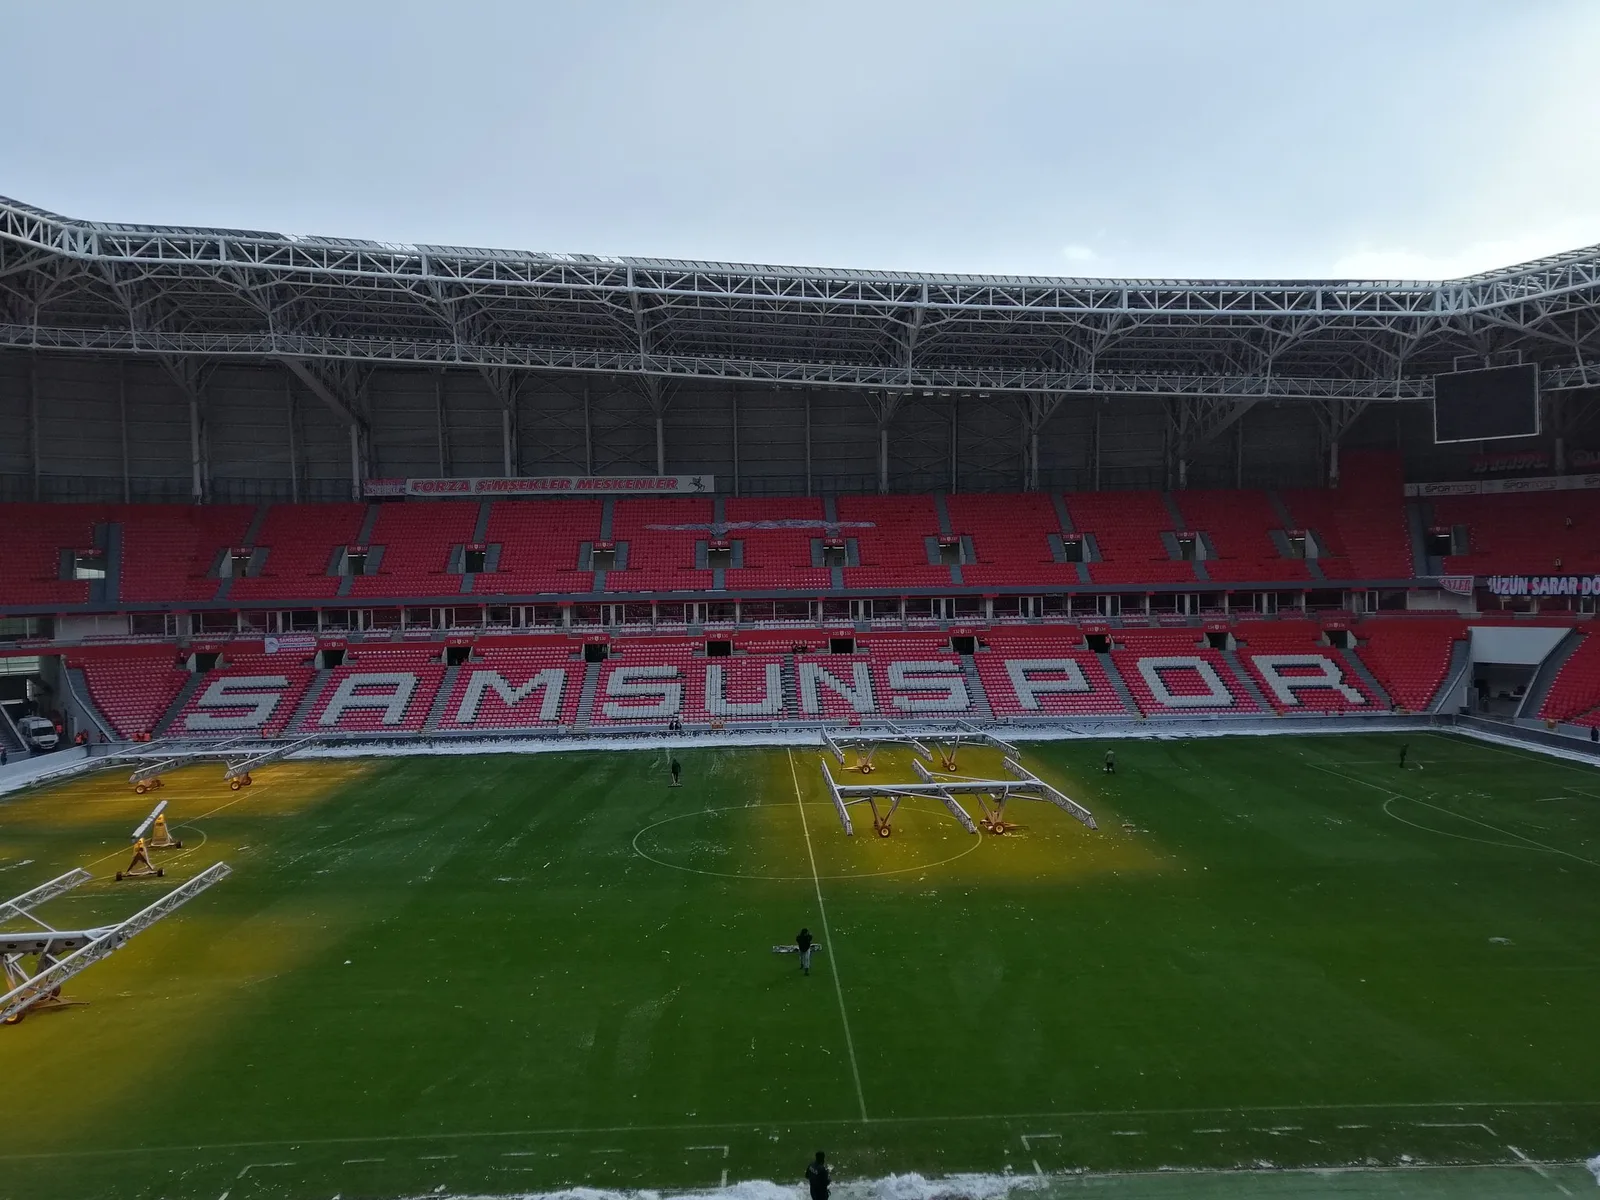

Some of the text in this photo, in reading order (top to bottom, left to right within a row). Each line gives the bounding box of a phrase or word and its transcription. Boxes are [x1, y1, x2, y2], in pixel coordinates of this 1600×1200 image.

[411, 479, 470, 493] FORZA
[574, 477, 678, 492] MESKENLER
[1531, 576, 1578, 595] SARAR
[184, 654, 1368, 732] SAMSUNSPOR
